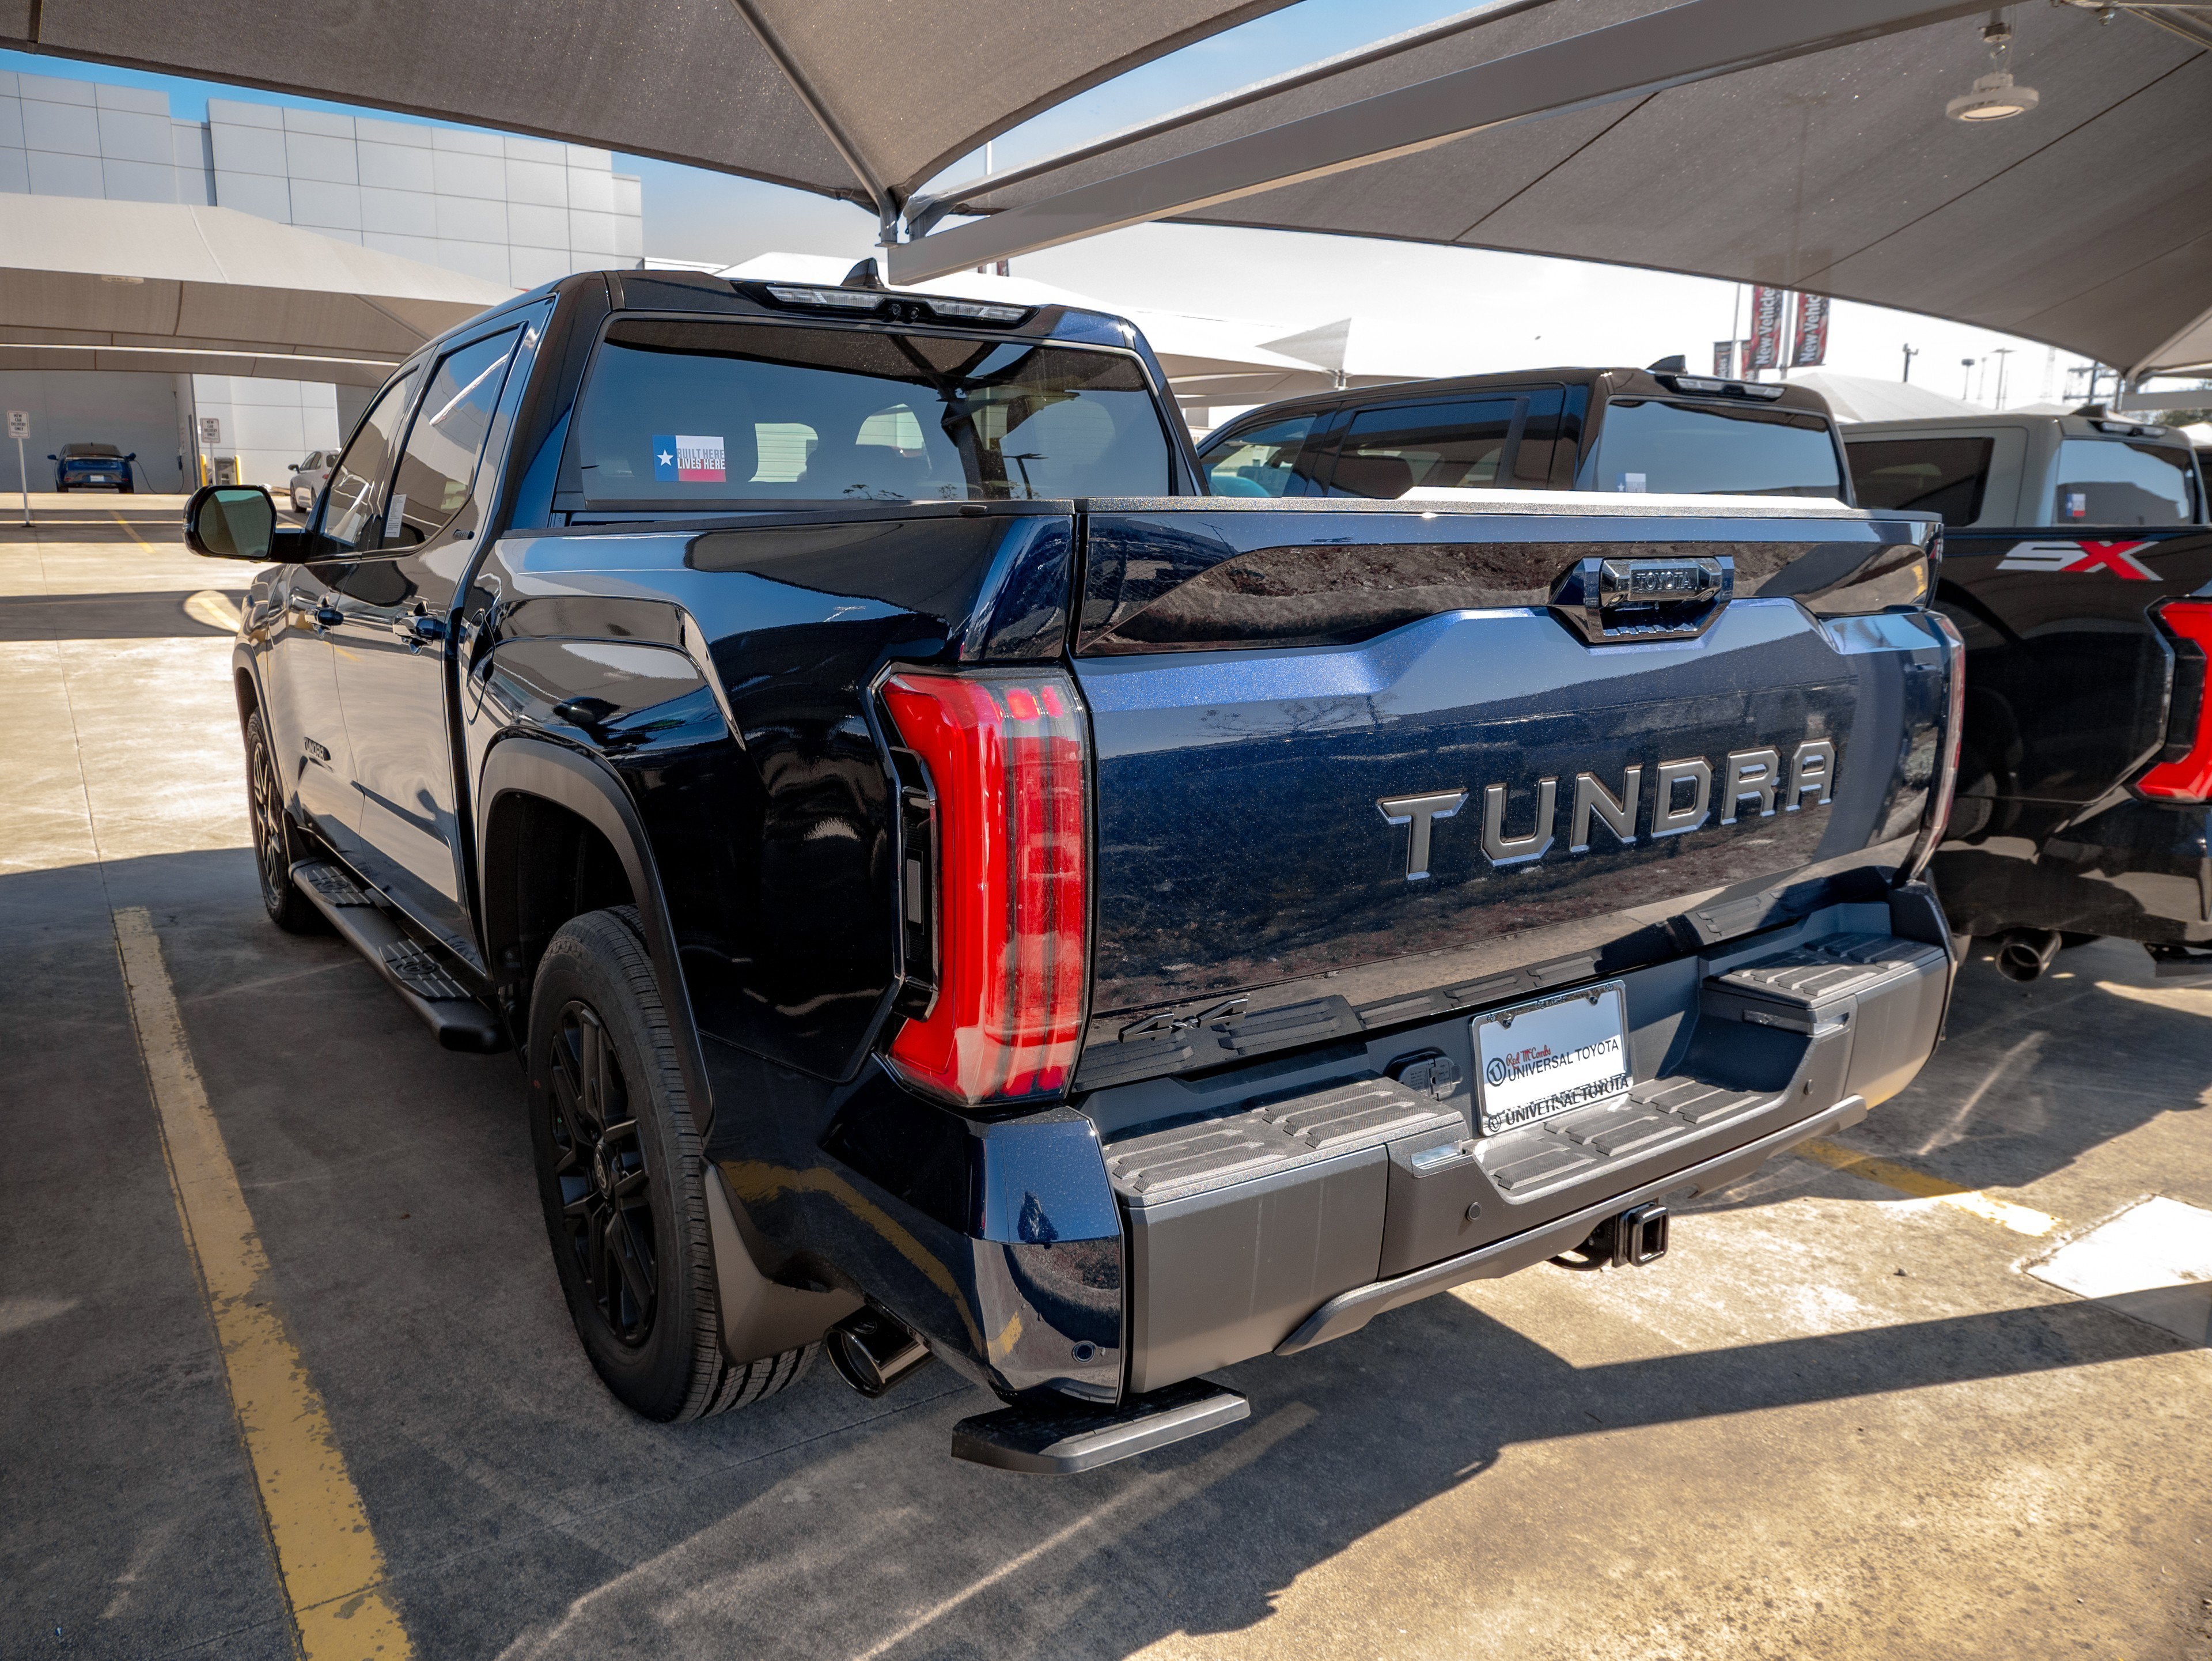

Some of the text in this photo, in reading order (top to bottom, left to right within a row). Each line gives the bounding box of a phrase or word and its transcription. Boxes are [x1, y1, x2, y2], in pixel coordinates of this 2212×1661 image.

[1755, 337, 1773, 365] New
[1799, 334, 1818, 362] New
[677, 448, 725, 460] BUILT HERE
[677, 458, 726, 470] LIVES HERE
[1996, 540, 2164, 581] SX
[1636, 571, 1694, 591] TOYOTA
[1377, 736, 1837, 881] TUNDRA
[1506, 1045, 1551, 1066] Red McCombs
[1508, 1039, 1619, 1081] UNIVERSAL TOYOTA
[1505, 1076, 1629, 1125] UNIVERSAL TOYOTA
